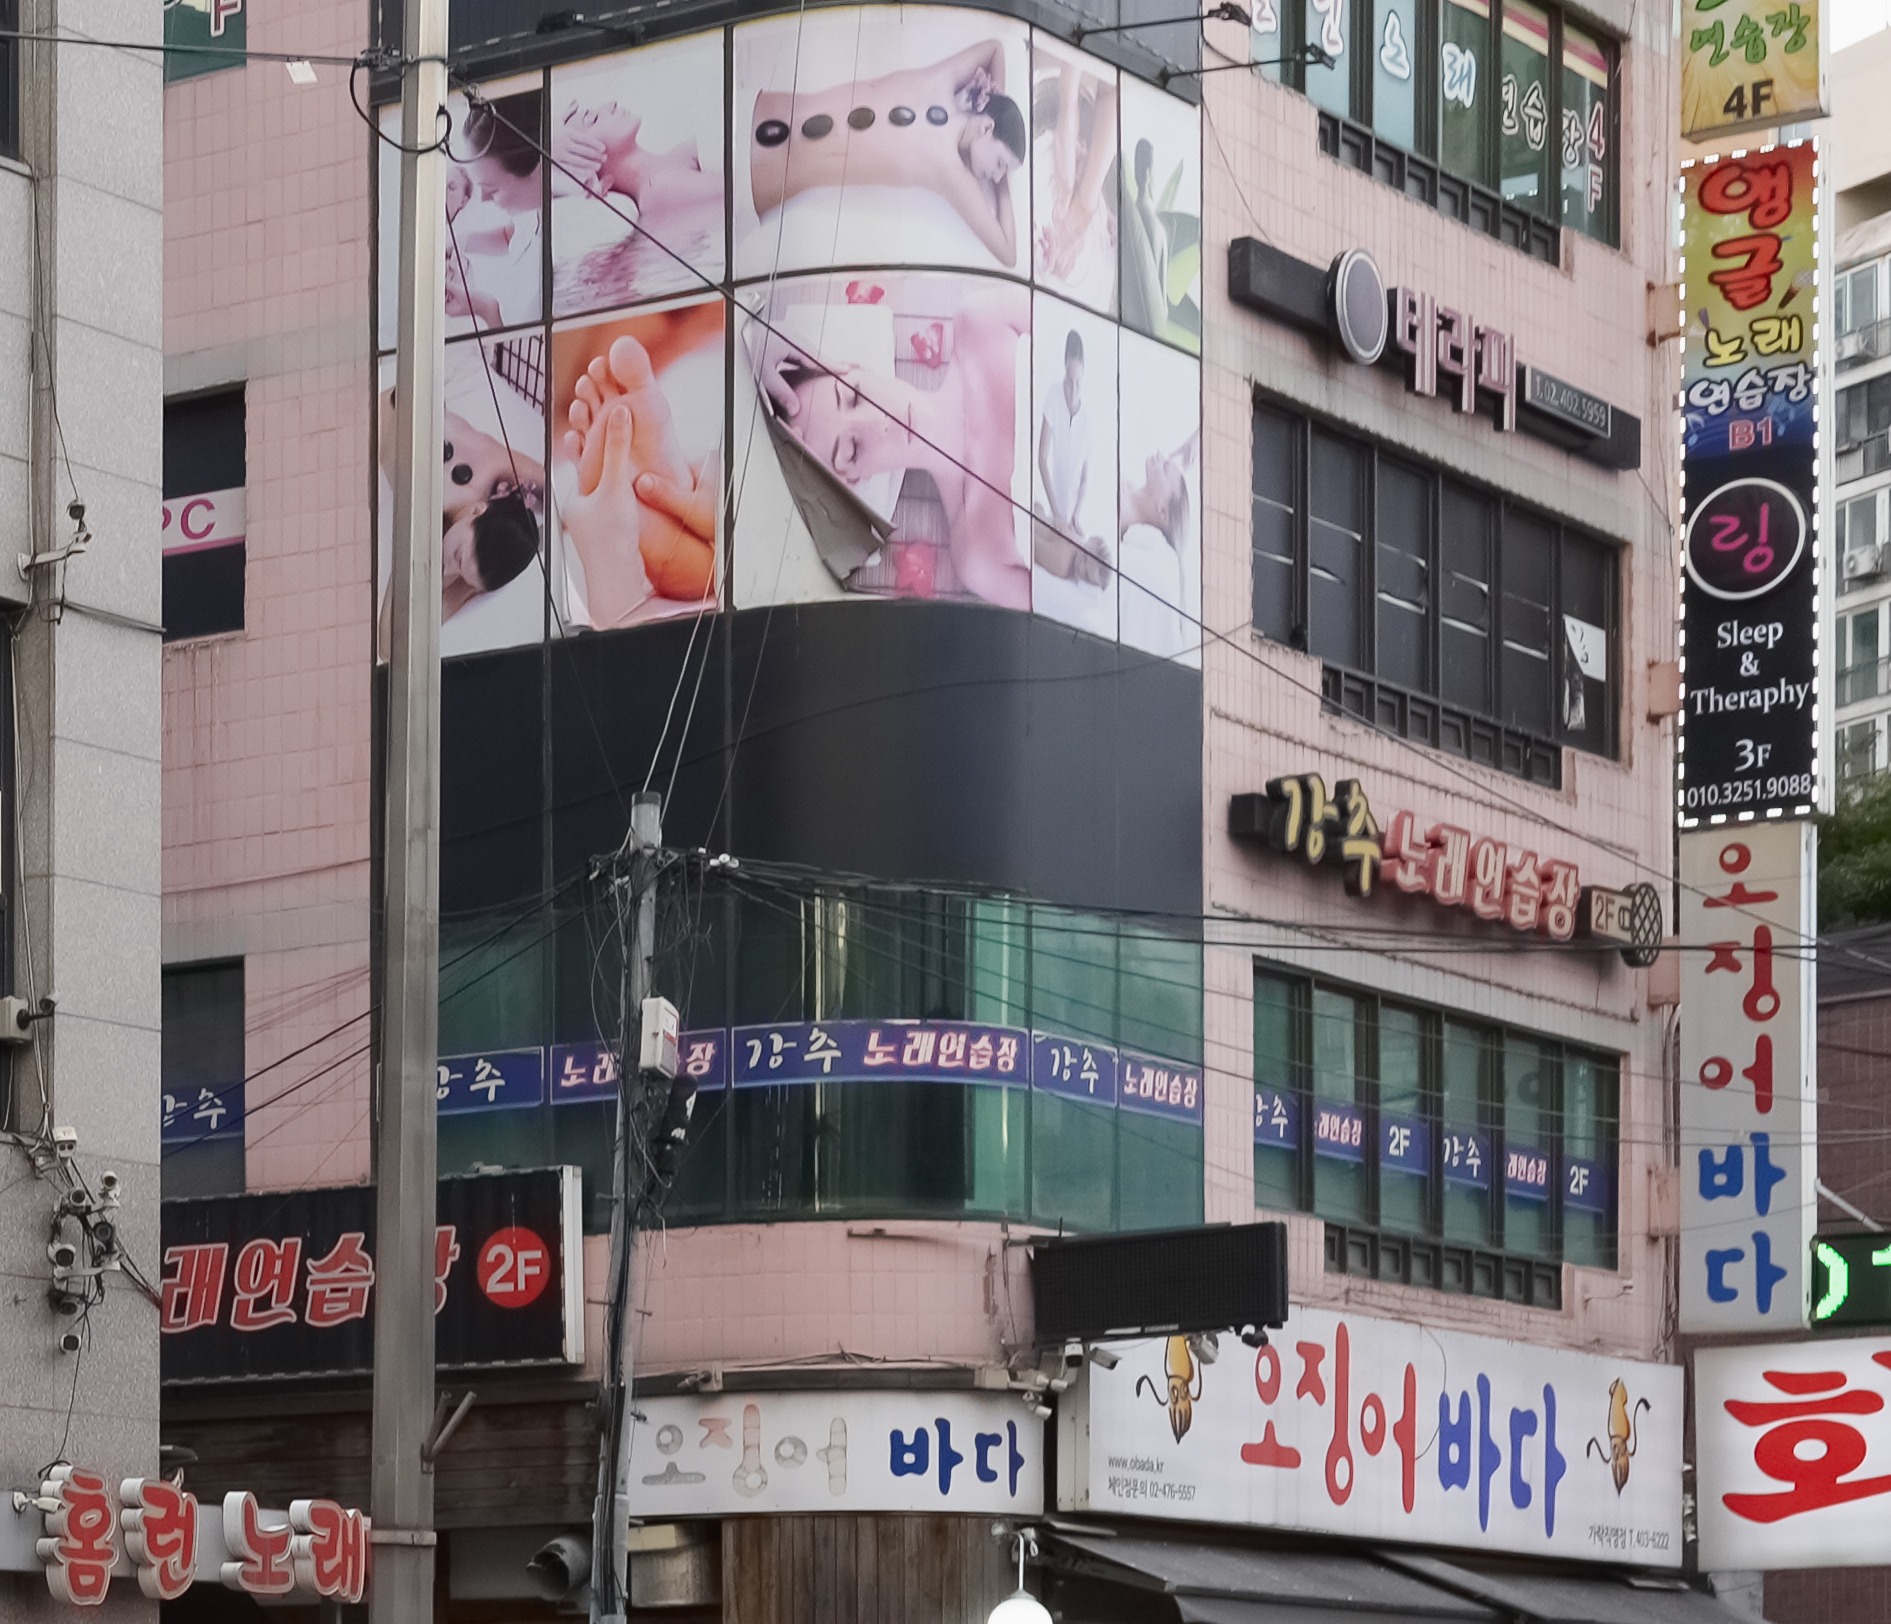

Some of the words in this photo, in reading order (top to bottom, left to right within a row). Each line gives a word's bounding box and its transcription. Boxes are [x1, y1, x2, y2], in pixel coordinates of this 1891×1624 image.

[1689, 4, 1810, 67] 연습장
[1724, 80, 1774, 118] 4F
[1397, 286, 1515, 432] 테라피
[1706, 314, 1804, 367] 노래
[1689, 363, 1812, 414] 연습장
[1729, 420, 1772, 450] B1
[1710, 502, 1773, 573] 링
[1717, 621, 1784, 649] Sleep
[1740, 652, 1760, 676] &
[1691, 678, 1810, 715] Theraphy
[1734, 739, 1772, 772] 3F
[1687, 774, 1812, 807] 010.3251.9088
[1393, 811, 1579, 939] 노래연습장
[1594, 898, 1616, 931] 2F
[1700, 842, 1779, 1114] 오징어
[561, 1042, 716, 1088] 노래장
[746, 1027, 842, 1073] 강수
[863, 1030, 1018, 1073] 노래연습장
[1050, 1045, 1099, 1093] 강수
[1124, 1064, 1197, 1109] 노래연습장
[1389, 1125, 1411, 1156] 2F
[1569, 1165, 1589, 1195] 2F
[1698, 1132, 1787, 1314] 바다
[161, 1225, 459, 1333] 래연습
[485, 1247, 544, 1294] 2F
[642, 1404, 848, 1496] 오징어
[889, 1417, 1024, 1497] 바다
[1240, 1321, 1416, 1514] 오징어
[1437, 1372, 1566, 1538] 바다
[1722, 1366, 1891, 1523] 호
[1108, 1455, 1164, 1473] www.obada.kr
[221, 1491, 367, 1604] 노래
